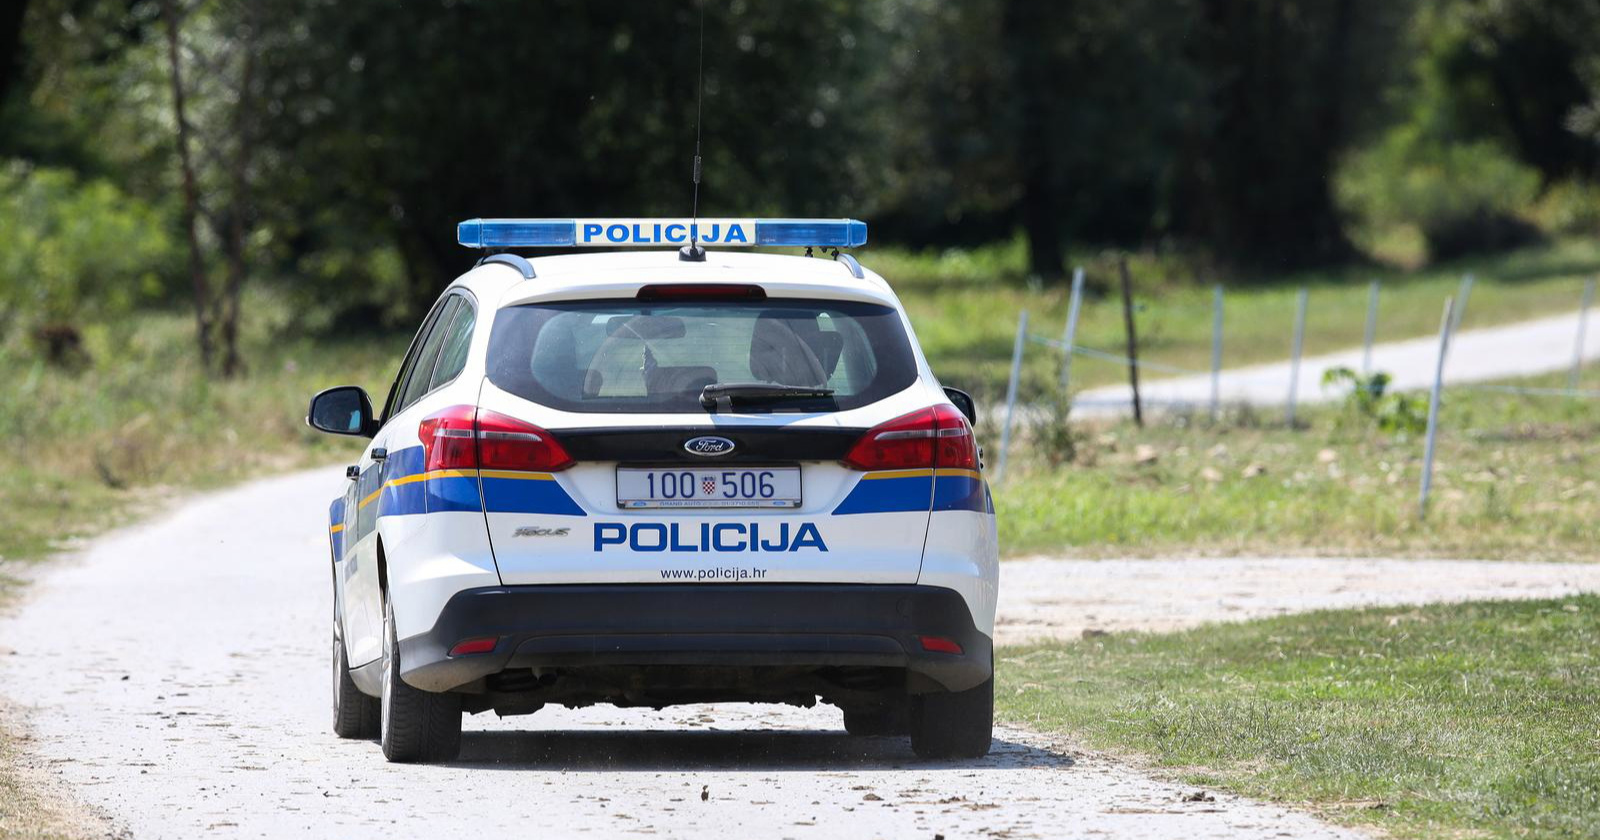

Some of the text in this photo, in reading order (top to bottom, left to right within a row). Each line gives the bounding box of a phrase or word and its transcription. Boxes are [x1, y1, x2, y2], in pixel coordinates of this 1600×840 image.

[583, 224, 747, 243] POLICIJA
[695, 439, 724, 452] Ford
[647, 472, 775, 498] 100 506
[594, 523, 829, 552] POLICIJA
[660, 567, 767, 581] www.policija.hr
